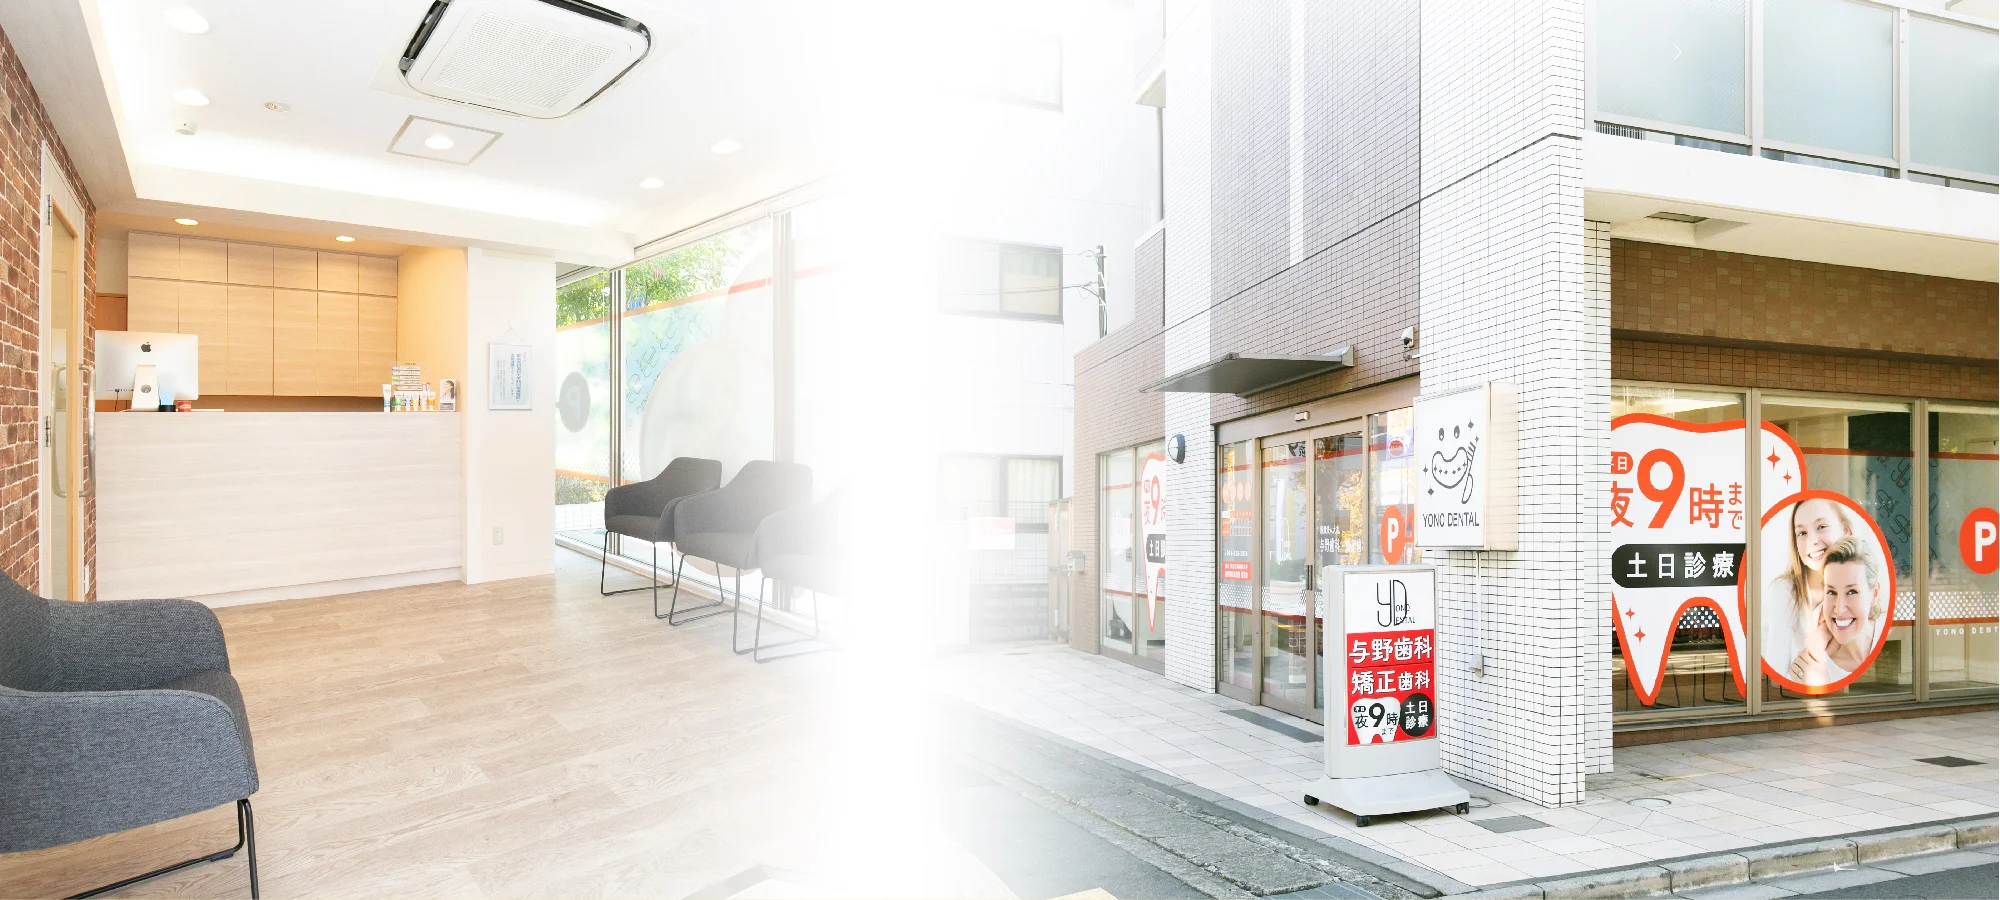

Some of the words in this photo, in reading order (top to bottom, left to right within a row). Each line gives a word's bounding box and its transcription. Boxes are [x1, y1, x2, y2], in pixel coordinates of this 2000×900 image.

[1423, 513, 1446, 528] YONO
[1447, 511, 1480, 527] DENTAL
[1387, 517, 1399, 553] P
[1975, 521, 1997, 562] P
[1626, 550, 1735, 579] 土日診療
[1935, 628, 1965, 636] YONO
[1971, 626, 1998, 635] DENT
[1348, 635, 1433, 664] 与野歯科
[1351, 669, 1431, 695] 矯正歯科
